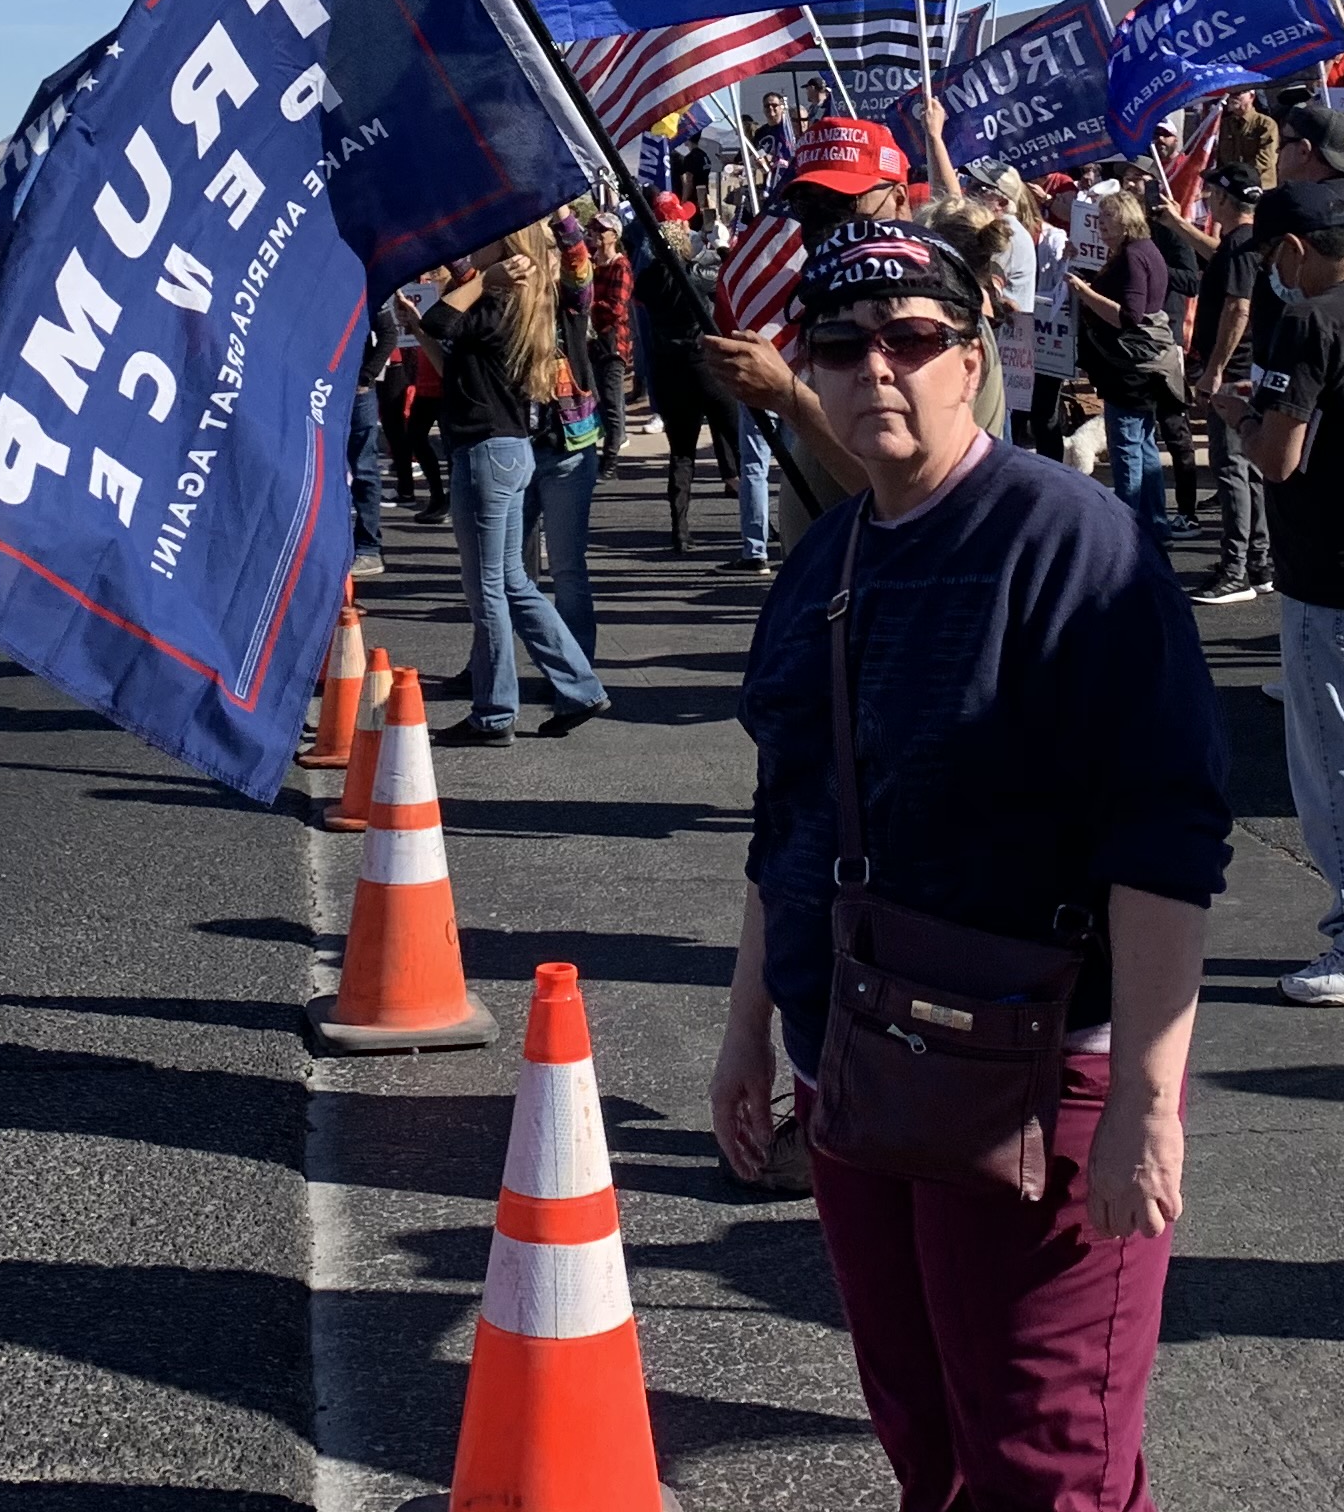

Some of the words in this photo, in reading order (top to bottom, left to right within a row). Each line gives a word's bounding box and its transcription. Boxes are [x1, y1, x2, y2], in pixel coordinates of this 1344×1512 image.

[818, 127, 869, 145] AMERICA
[823, 147, 860, 162] AGAIN
[815, 221, 905, 256] RUM
[1079, 243, 1112, 261] STE
[829, 258, 903, 290] 2020
